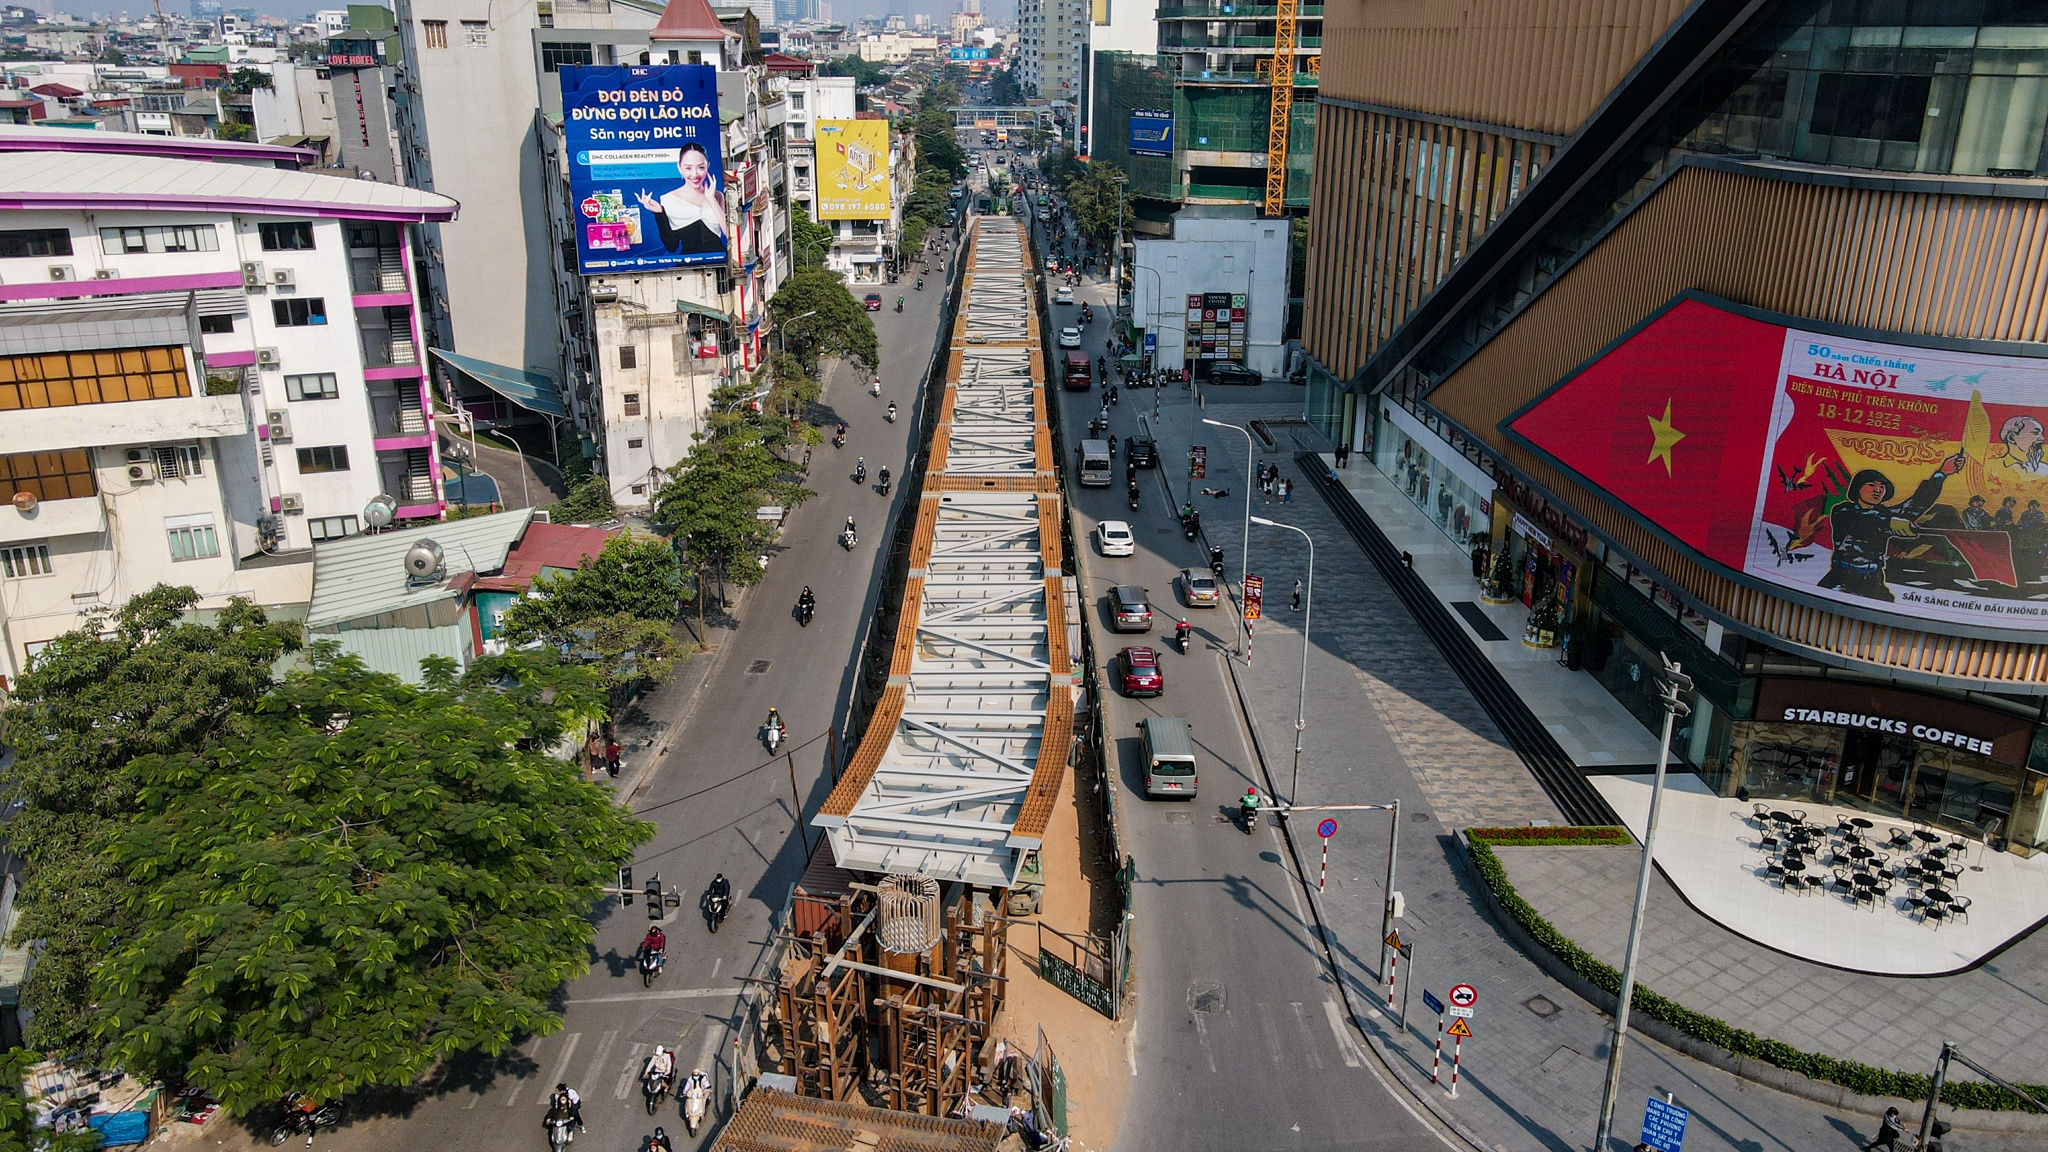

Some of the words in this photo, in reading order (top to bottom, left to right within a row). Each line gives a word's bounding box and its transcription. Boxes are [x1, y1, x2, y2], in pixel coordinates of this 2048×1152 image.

[328, 55, 348, 65] LOVE
[349, 55, 375, 65] HOTEL
[631, 68, 648, 76] DHC
[598, 89, 626, 106] ĐỢI
[629, 88, 659, 102] ĐÈN
[662, 86, 684, 102] ĐỎ
[572, 105, 616, 120] ĐỪNG
[620, 107, 647, 123] ĐỢI
[650, 105, 678, 120] LÃO
[681, 103, 712, 119] HOÁ
[590, 128, 615, 140] Săn
[618, 130, 650, 141] ngay
[653, 127, 682, 139] DHC
[1807, 344, 1831, 358] 50
[1851, 353, 1882, 368] Chiến
[1884, 357, 1916, 373] thắng
[1813, 362, 1847, 381] HÀ
[1853, 368, 1899, 390] NỘI
[1791, 381, 1814, 396] ĐIỆN
[1815, 386, 1839, 400] BIÊN
[1865, 394, 1894, 409] TRÊN
[1897, 399, 1939, 415] KHÔNG
[1817, 402, 1864, 425] 18-12
[1869, 411, 1902, 422] 1972
[1865, 419, 1901, 430] 2022
[1924, 595, 1950, 607] SÀNG
[1952, 601, 1982, 611] CHIẾN
[2006, 606, 2038, 616] KHÔNG
[1783, 708, 1908, 734] STARBUCKS
[1911, 724, 1994, 756] COFFEE
[1650, 1101, 1664, 1111] CÔNG
[1671, 1116, 1685, 1126] CÔNG
[1642, 1127, 1657, 1137] QUAN
